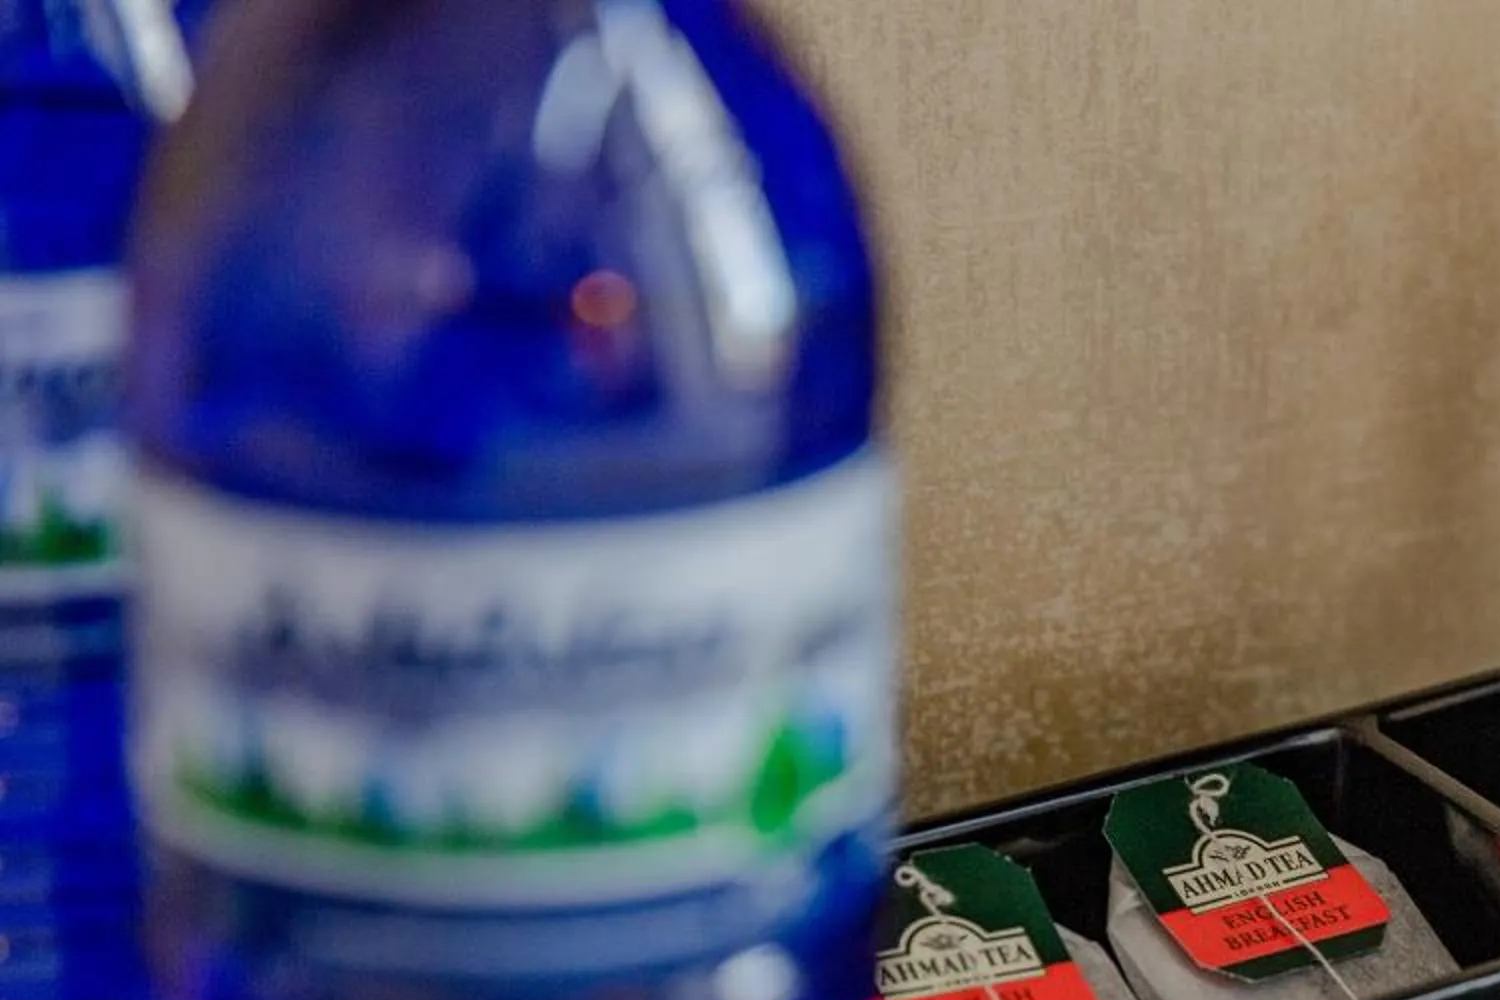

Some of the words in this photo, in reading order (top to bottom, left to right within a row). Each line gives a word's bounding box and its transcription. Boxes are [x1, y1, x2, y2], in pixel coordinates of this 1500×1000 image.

[1264, 850, 1314, 876] TEA
[879, 951, 978, 986] AHMAD
[979, 943, 1034, 967] TEA
